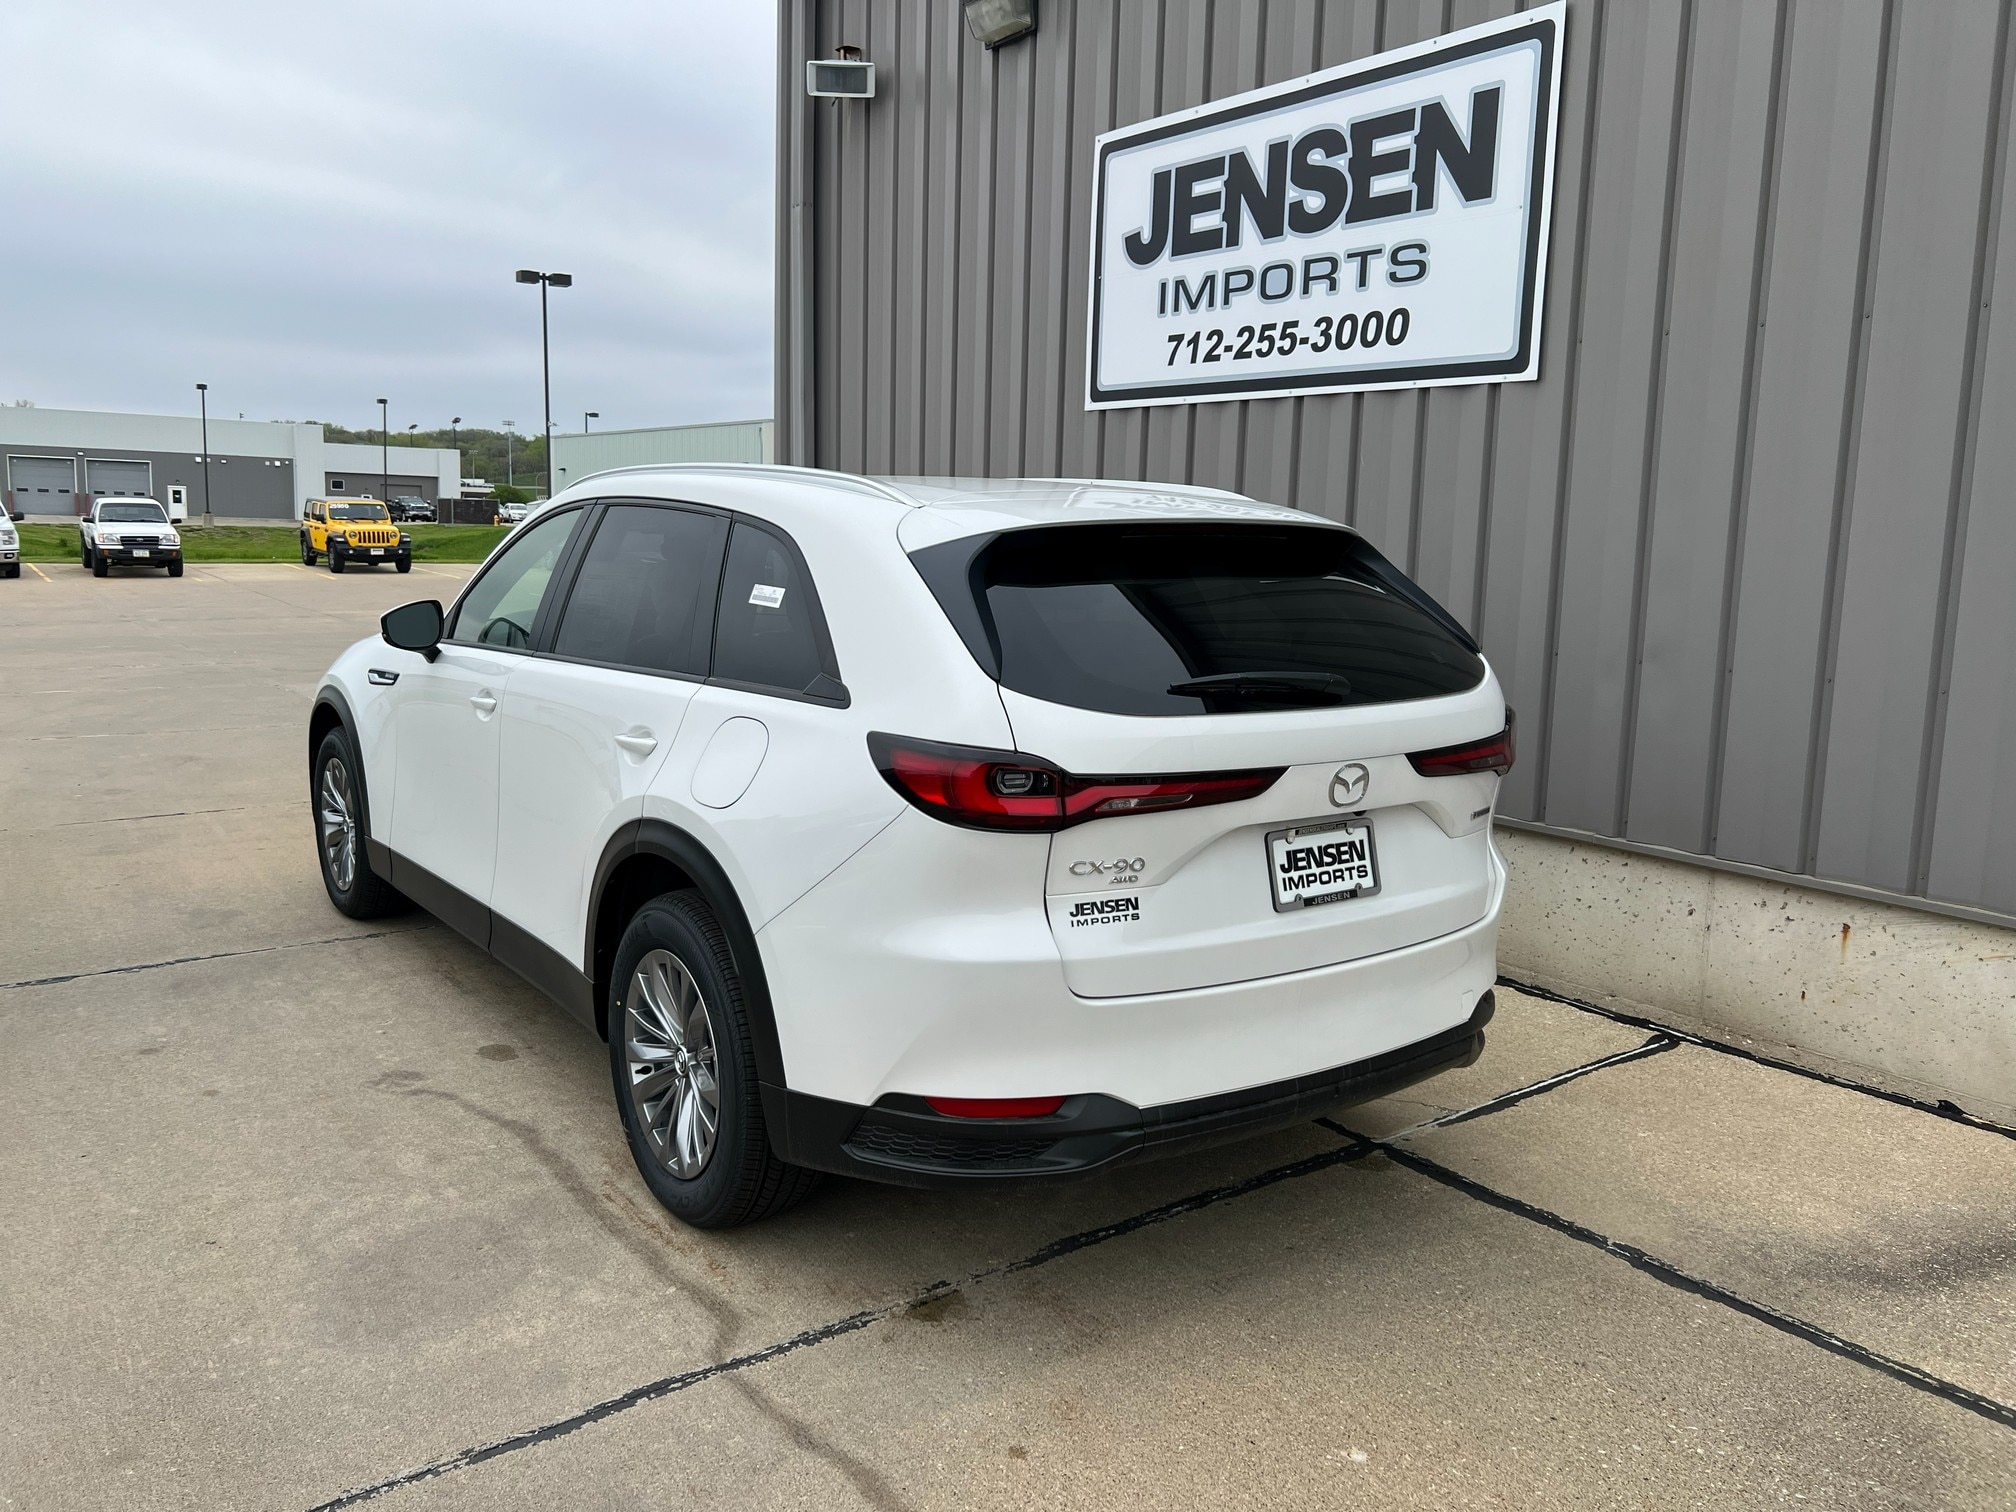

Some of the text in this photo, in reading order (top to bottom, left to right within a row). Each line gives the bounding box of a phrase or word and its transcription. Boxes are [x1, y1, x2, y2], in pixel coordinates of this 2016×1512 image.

[1124, 86, 1501, 266] JENSEN
[1158, 243, 1429, 316] IMPORTS
[1166, 306, 1411, 367] 712-255-3000
[1068, 857, 1146, 876] CX-90
[1279, 839, 1366, 874] JENSEN
[1109, 874, 1139, 885] AWD
[1282, 864, 1369, 892] IMPORTS
[1069, 896, 1140, 918] JENSEN
[1312, 891, 1351, 905] JENSEN
[1070, 912, 1141, 928] IMPORTS
